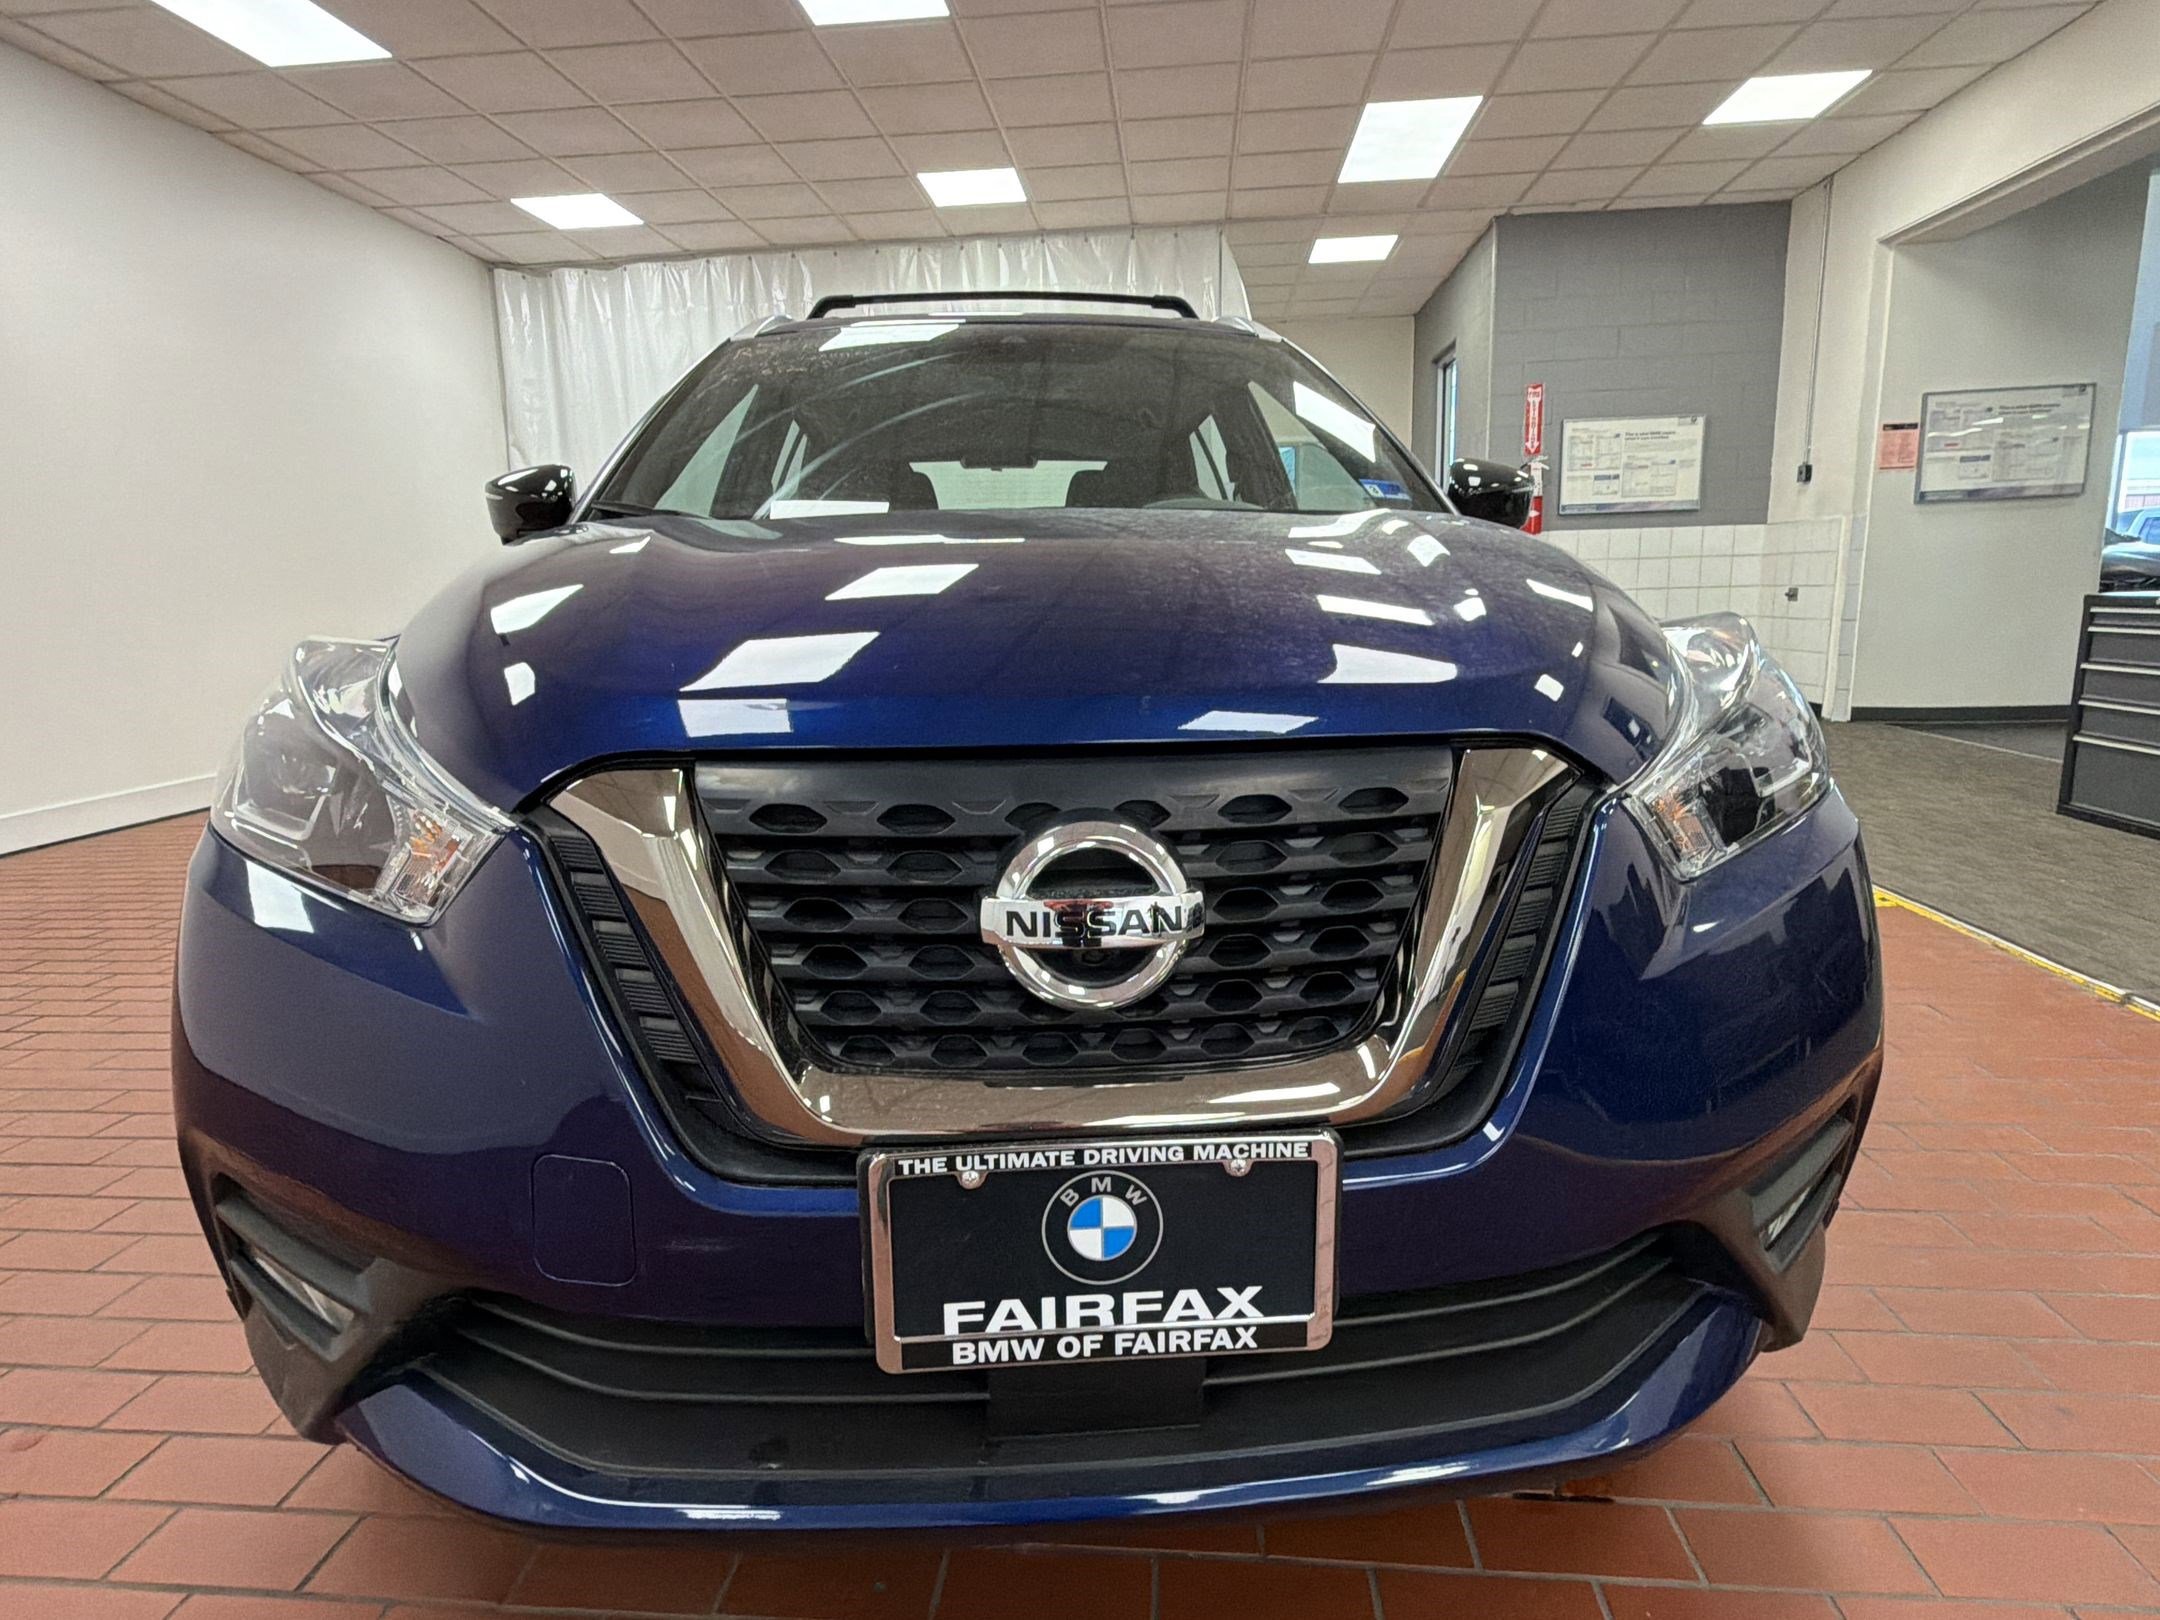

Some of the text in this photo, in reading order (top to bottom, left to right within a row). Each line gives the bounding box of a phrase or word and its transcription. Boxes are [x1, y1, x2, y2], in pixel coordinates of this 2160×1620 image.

[1006, 906, 1182, 938] NISSAN
[898, 1142, 1309, 1176] THE ULTIMATE DRIVING MACHINE
[1060, 1176, 1148, 1207] BMW
[943, 1285, 1264, 1335] FAIRFAX
[952, 1326, 1257, 1365] BMW OF FAIRFAX
